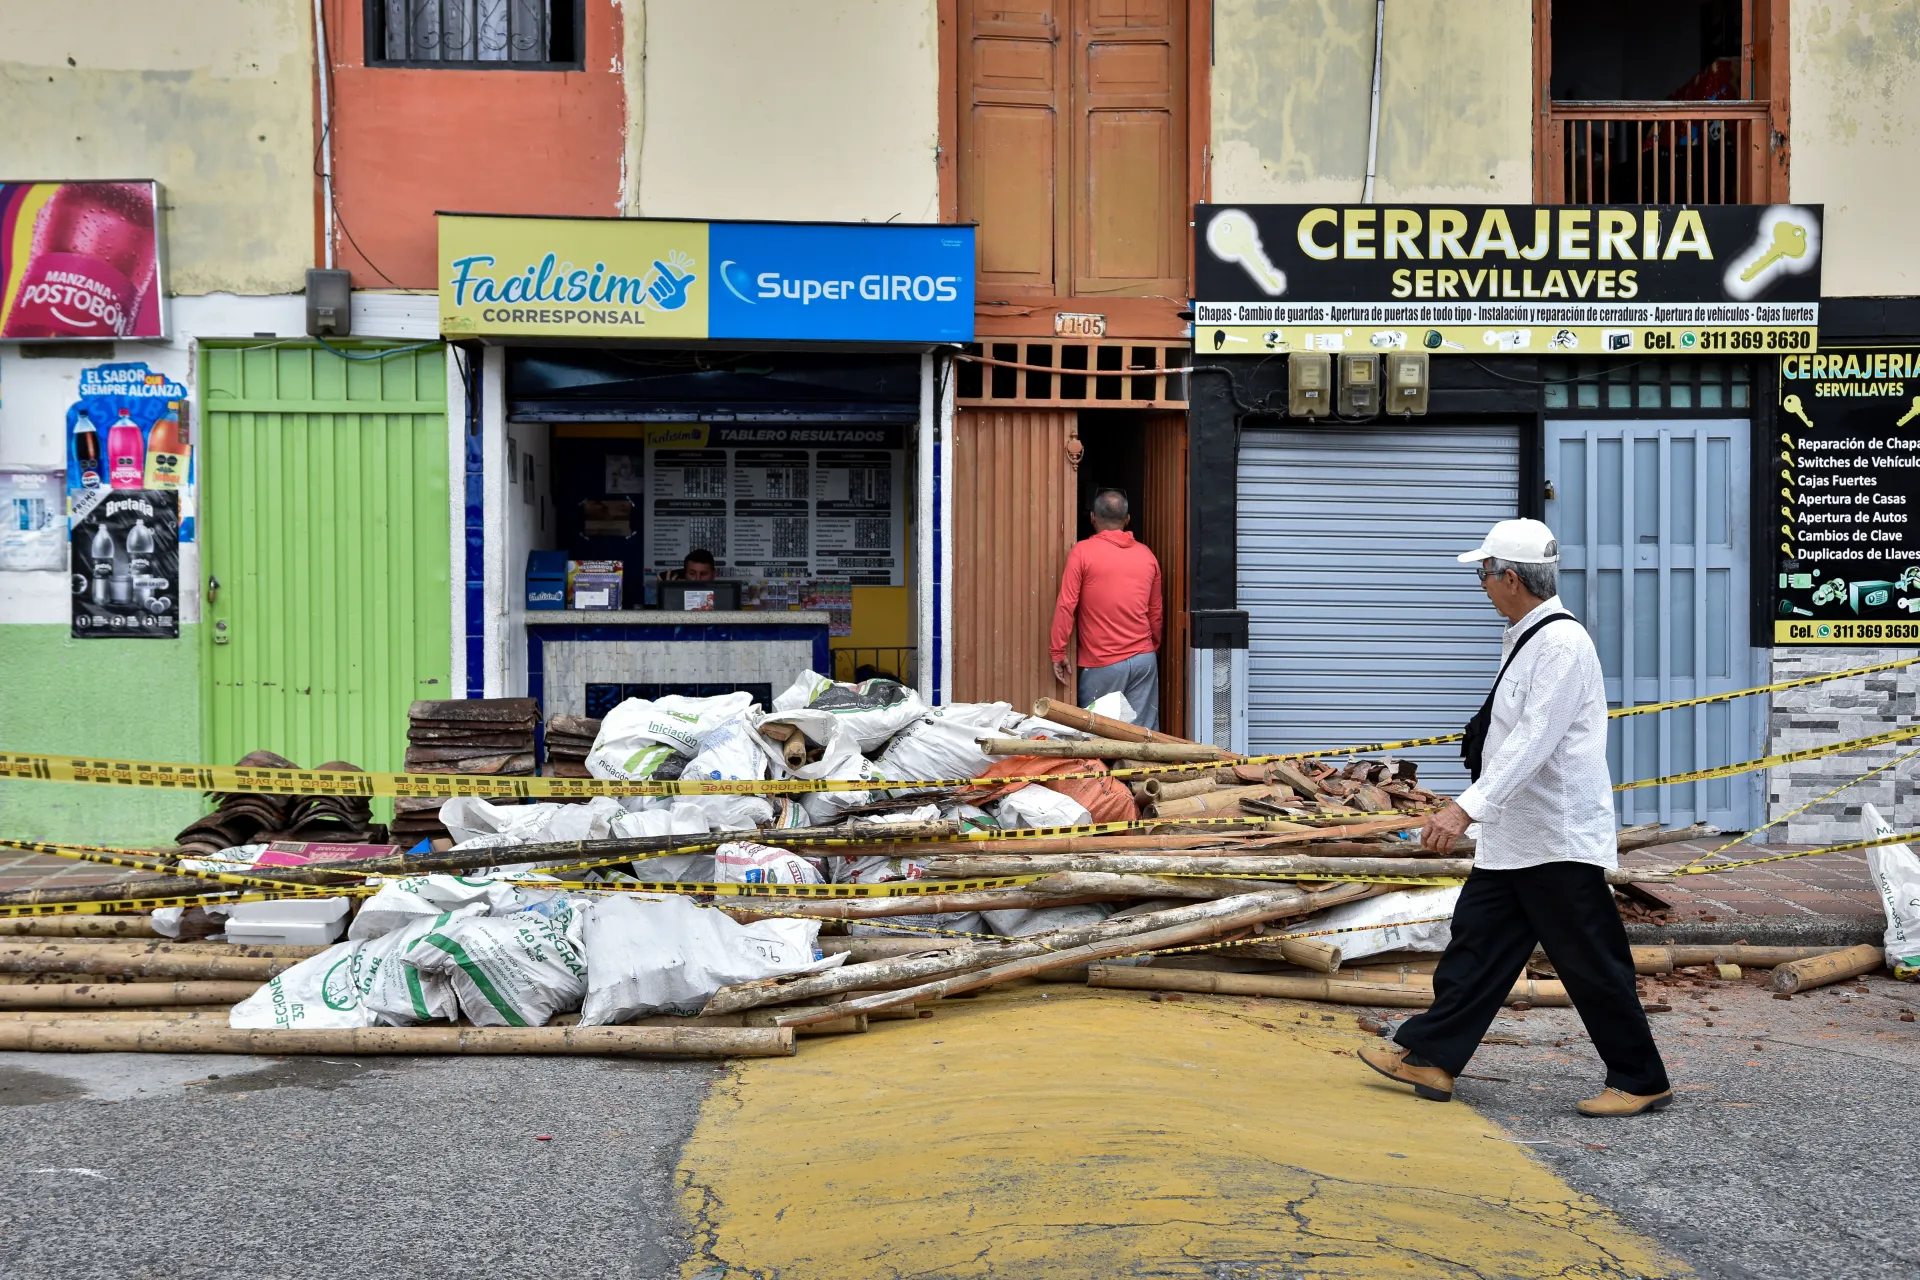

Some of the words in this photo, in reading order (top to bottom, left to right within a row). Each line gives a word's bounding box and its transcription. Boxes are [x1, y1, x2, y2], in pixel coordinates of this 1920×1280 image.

[1297, 208, 1714, 261] CERRAJERIA
[45, 270, 112, 299] MANZANA
[1391, 268, 1638, 299] SERVILLAVES
[483, 308, 645, 325] CORRESPONSAL
[1199, 306, 1232, 322] Chapas
[1239, 306, 1272, 320] Cambio
[1275, 306, 1286, 320] de
[1288, 306, 1324, 323] guardas
[1331, 306, 1369, 322] Apertura
[1372, 306, 1382, 321] de
[1384, 307, 1419, 323] puertas
[1421, 306, 1431, 321] de
[1433, 306, 1453, 321] todo
[1454, 306, 1472, 322] tipo
[1479, 305, 1528, 321] Instalación
[1530, 309, 1536, 322] y
[1536, 306, 1585, 322] reparación
[1587, 307, 1598, 321] de
[1600, 306, 1648, 322] cerraduras
[1654, 306, 1693, 322] Apertura
[1694, 307, 1706, 322] de
[1707, 306, 1749, 322] vehículos
[1756, 306, 1780, 323] Cajas
[1782, 306, 1814, 322] fuertes
[1059, 317, 1102, 335] 11-05
[1644, 331, 1675, 350] Cel.
[1700, 331, 1727, 350] 311
[1730, 331, 1764, 350] 369
[1767, 331, 1811, 350] 3630
[87, 370, 100, 384] EL
[102, 369, 145, 383] SABOR
[81, 383, 128, 396] SIEMPRE
[128, 384, 182, 397] ALCANZA
[1815, 382, 1904, 397] SERVILLAVES
[721, 429, 786, 441] TABLERO
[790, 430, 885, 442] RESULTADOS
[1798, 437, 1865, 452] Reparación
[1868, 437, 1884, 449] de
[1798, 456, 1851, 468] Switches
[1853, 456, 1869, 468] de
[1798, 475, 1829, 488] Cajas
[1832, 475, 1877, 486] Fuertes
[72, 491, 96, 513] PROMO
[105, 498, 154, 518] Bretaña
[1798, 493, 1851, 507] Apertura
[1854, 493, 1870, 504] de
[1872, 493, 1907, 504] Casas
[1798, 512, 1851, 526] Apertura
[1854, 511, 1870, 523] de
[1872, 512, 1908, 523] Autos
[1798, 529, 1850, 542] Cambios
[1852, 529, 1868, 542] de
[1870, 529, 1903, 542] Clave
[1798, 548, 1864, 562] Duplicados
[1866, 548, 1882, 560] de
[1886, 548, 1920, 560] Llaves
[1790, 624, 1814, 638] Cel.
[1833, 624, 1854, 638] 311
[1857, 624, 1882, 638] 369
[1885, 624, 1919, 638] 3630
[648, 721, 698, 748] Iniciación
[597, 758, 629, 781] niciación
[519, 928, 536, 945] 40
[534, 943, 549, 963] kg
